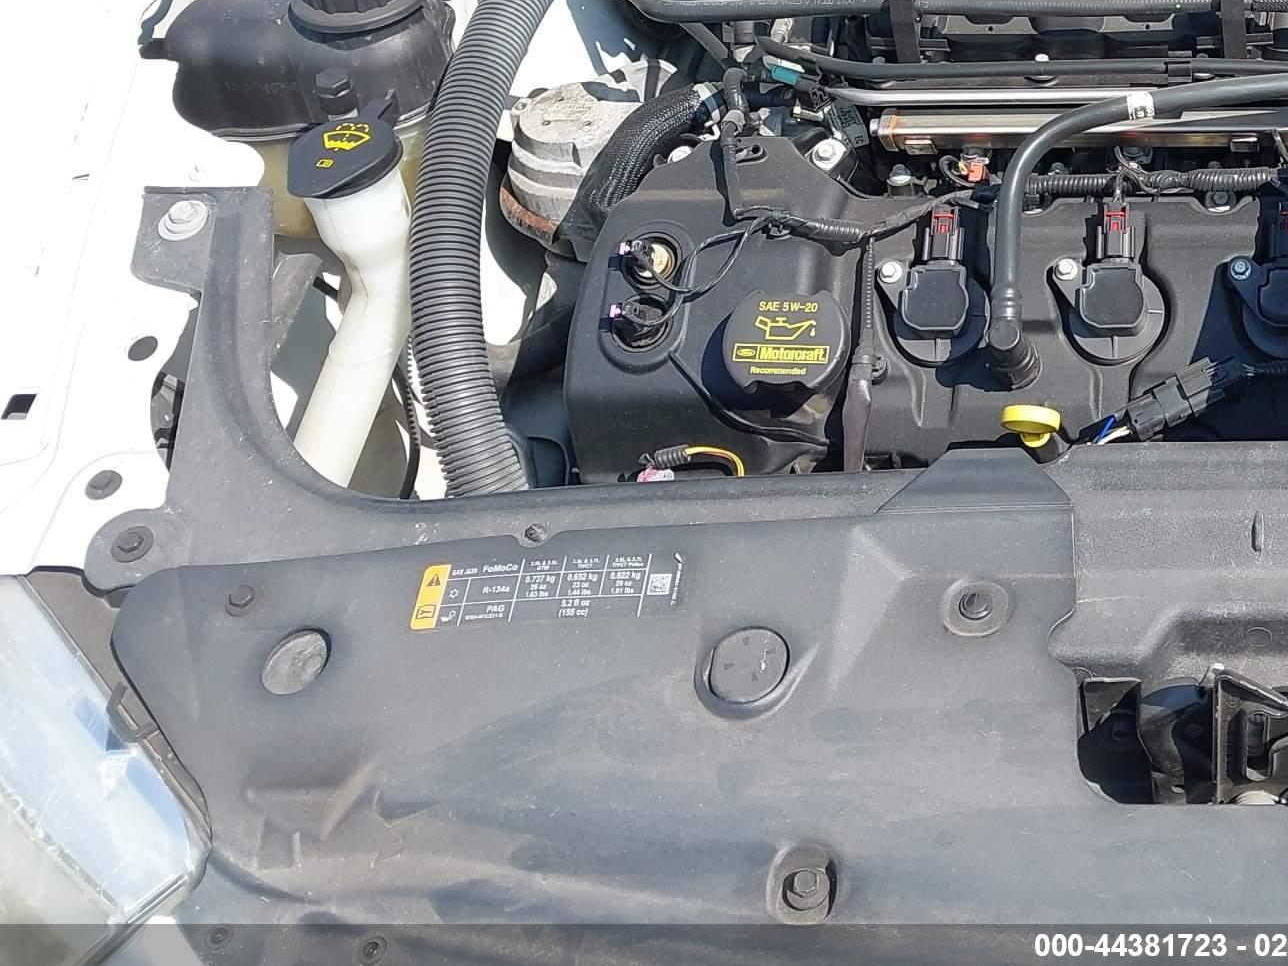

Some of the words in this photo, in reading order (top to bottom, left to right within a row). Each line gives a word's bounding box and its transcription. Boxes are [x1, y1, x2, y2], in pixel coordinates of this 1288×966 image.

[759, 301, 780, 311] SAE
[750, 366, 807, 375] Recommended
[482, 563, 519, 573] FoMoCo
[525, 574, 545, 583] 0.737
[545, 574, 556, 584] kg
[588, 572, 598, 582] kg
[631, 570, 641, 580] kg
[482, 586, 510, 594] R-134a
[560, 599, 573, 607] 5.2
[486, 604, 505, 613] PAG
[558, 608, 575, 618] (155
[576, 607, 588, 617] cc)
